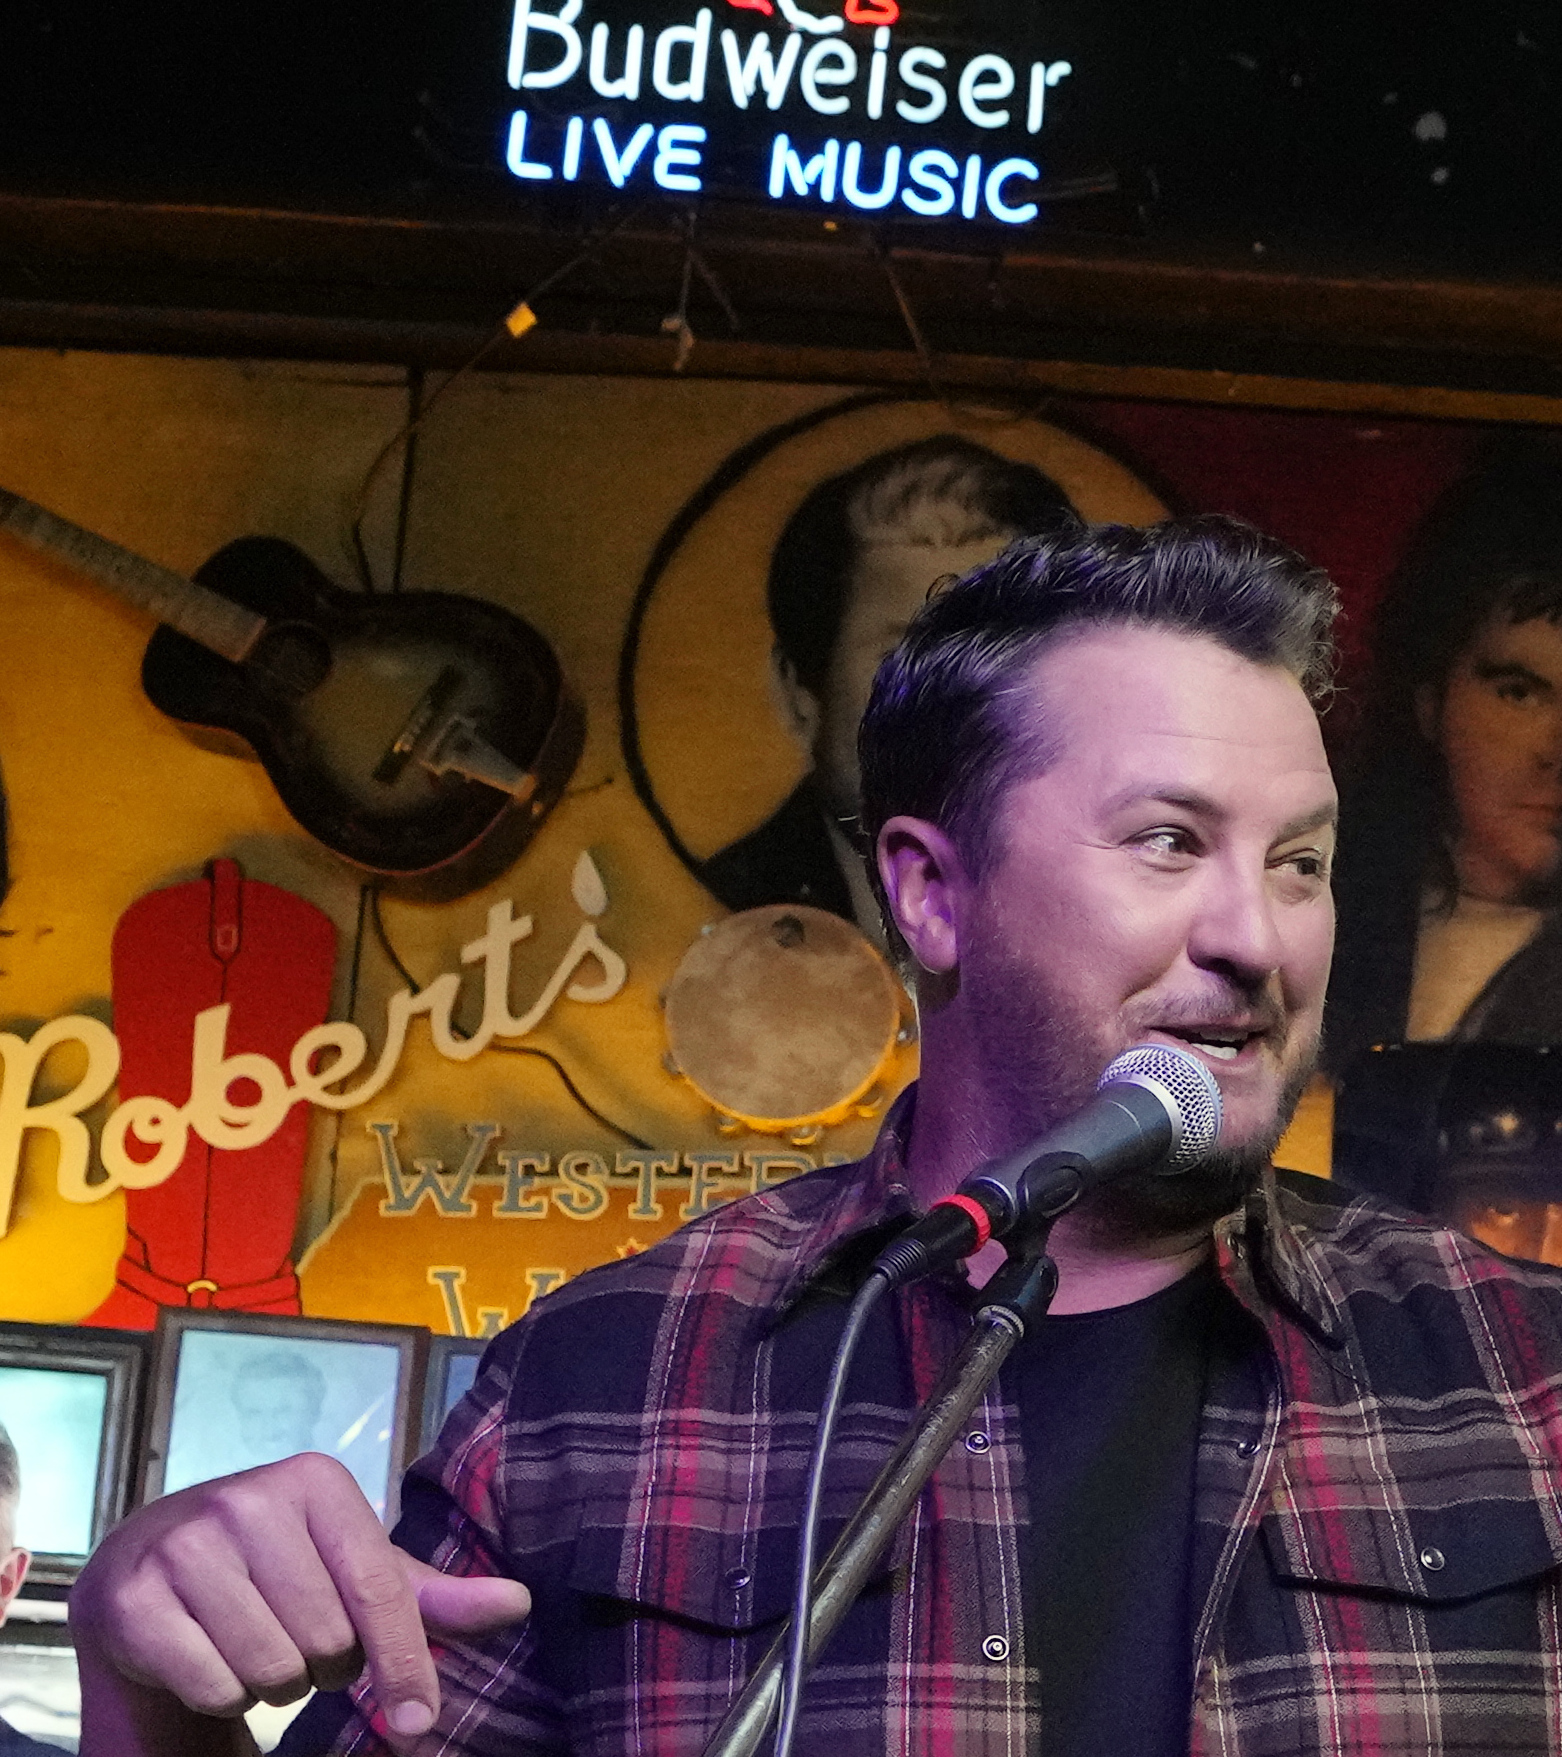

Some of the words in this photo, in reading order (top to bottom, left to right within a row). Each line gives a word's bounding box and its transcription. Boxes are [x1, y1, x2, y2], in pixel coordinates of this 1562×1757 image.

[507, 0, 1072, 134] Budweiser
[506, 110, 706, 192] LIVE
[768, 133, 1040, 224] MUSIC
[0, 850, 627, 1238] Robert's
[366, 1119, 873, 1221] WESTER
